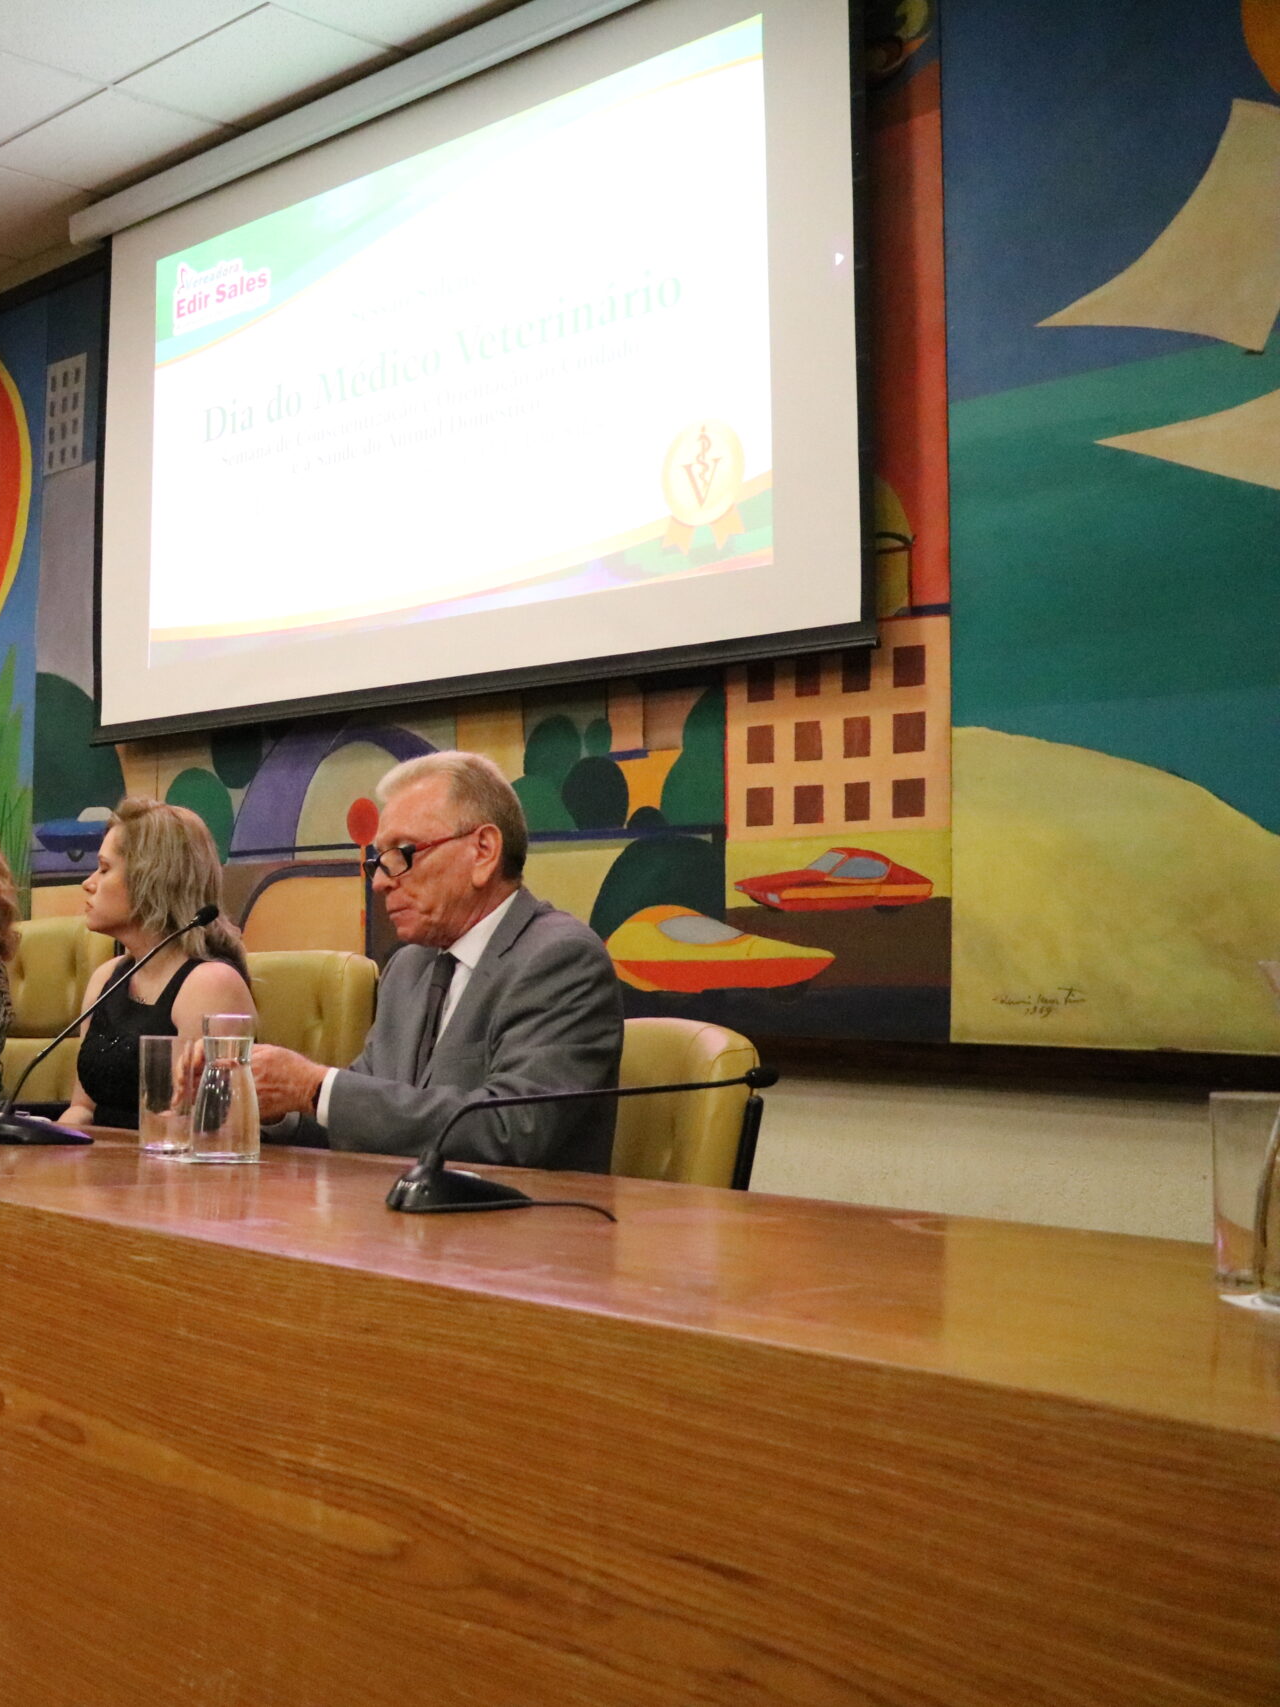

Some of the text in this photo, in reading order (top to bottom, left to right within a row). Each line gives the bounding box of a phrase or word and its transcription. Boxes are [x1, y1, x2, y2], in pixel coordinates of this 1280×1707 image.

[176, 291, 211, 319] Edir
[215, 272, 268, 304] Sales
[202, 268, 682, 442] Dia do Médico Veterinário
